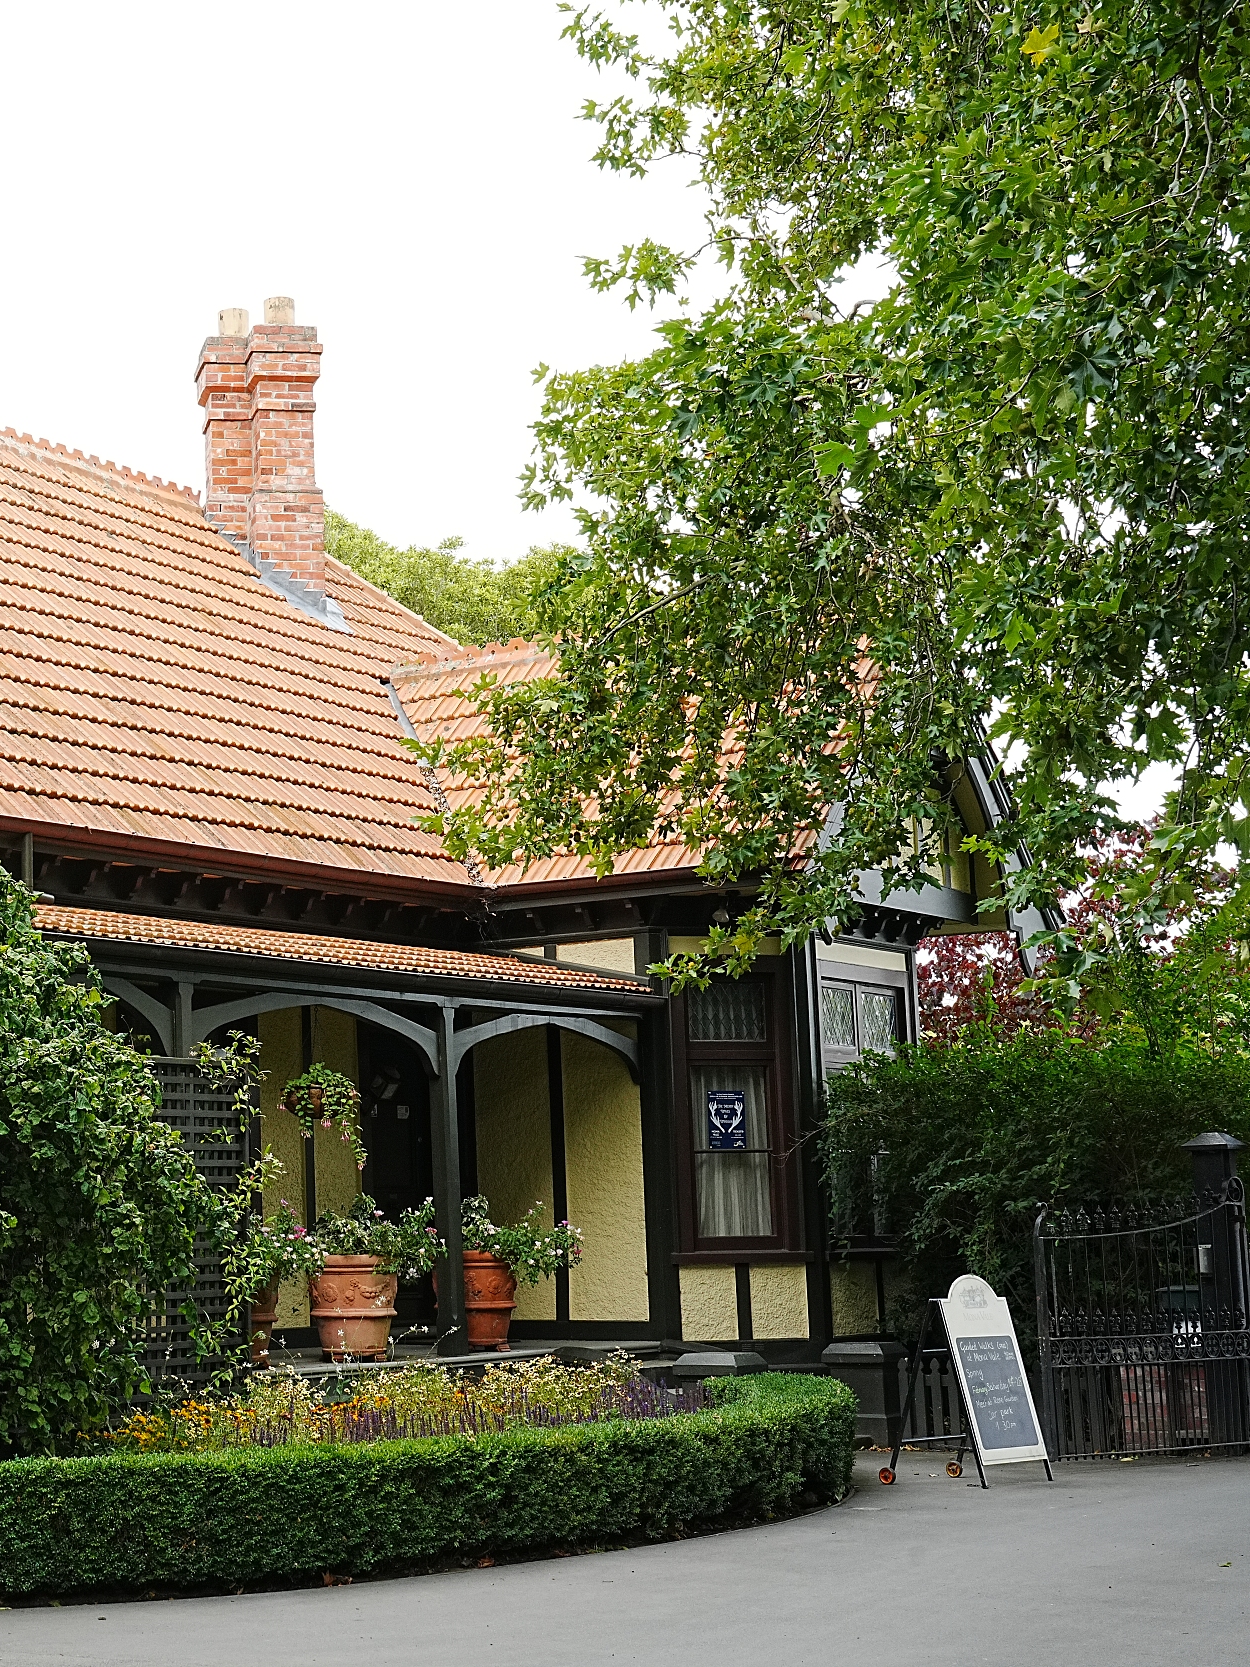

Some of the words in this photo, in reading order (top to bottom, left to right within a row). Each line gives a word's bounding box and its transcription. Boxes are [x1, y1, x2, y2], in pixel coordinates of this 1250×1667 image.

[959, 1341, 978, 1353] Guided
[977, 1341, 995, 1350] Walks
[973, 1352, 988, 1362] Mona
[965, 1368, 984, 1381] Spring
[1000, 1406, 1014, 1420] park
